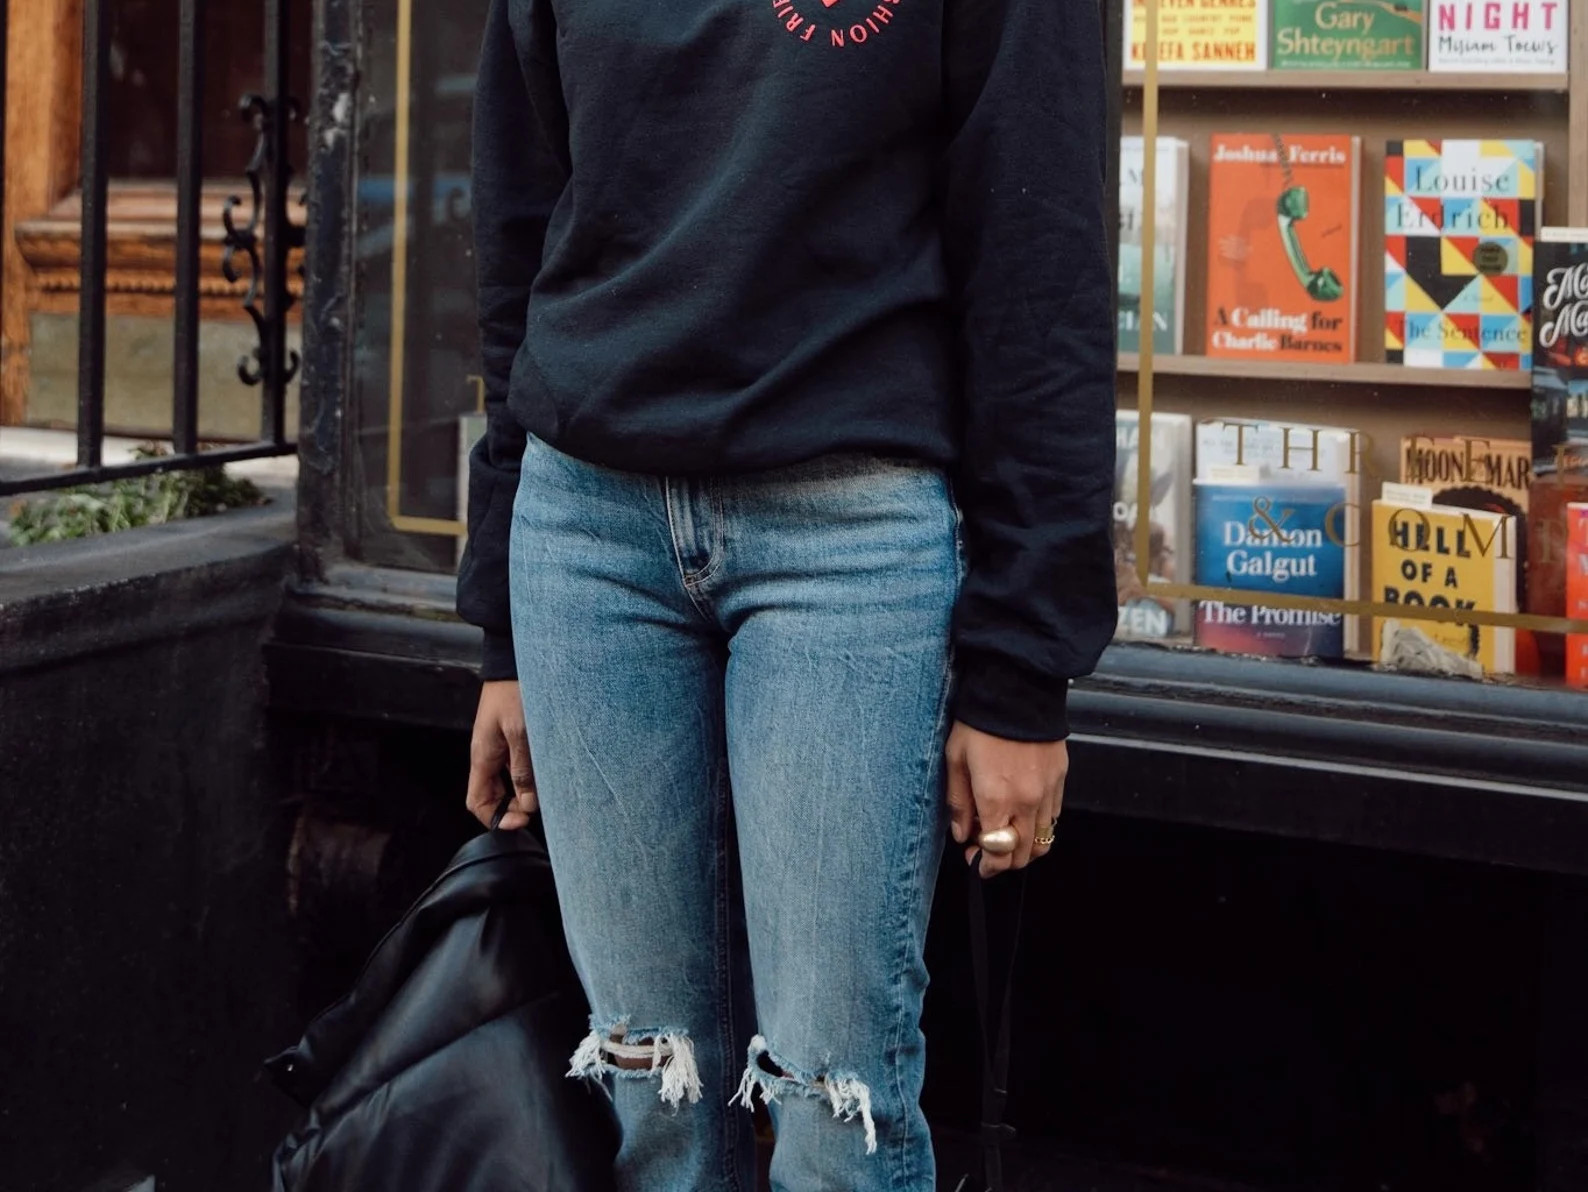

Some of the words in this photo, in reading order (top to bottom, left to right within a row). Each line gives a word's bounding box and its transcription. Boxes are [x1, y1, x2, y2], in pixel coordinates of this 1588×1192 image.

[1315, 1, 1374, 35] Gary
[1438, 2, 1558, 31] NIGHT
[1192, 42, 1255, 62] SANNEH
[1277, 27, 1414, 64] Shteyngart
[1214, 144, 1278, 163] Joshua
[1289, 145, 1346, 164] Ferris
[1415, 166, 1511, 192] Louise
[1396, 202, 1510, 229] Erdrich
[1214, 307, 1228, 326] A
[1231, 307, 1308, 334] Calling
[1311, 311, 1343, 331] for
[1438, 319, 1528, 342] Sentence
[1211, 331, 1277, 353] Charlie
[1280, 334, 1343, 353] Barnes
[1223, 520, 1323, 548] Damon
[1393, 521, 1471, 559] HELL
[1226, 548, 1318, 584] Galgut
[1401, 559, 1432, 583] OF
[1444, 566, 1458, 588] A
[1200, 600, 1246, 624] The
[1251, 605, 1341, 626] Promise
